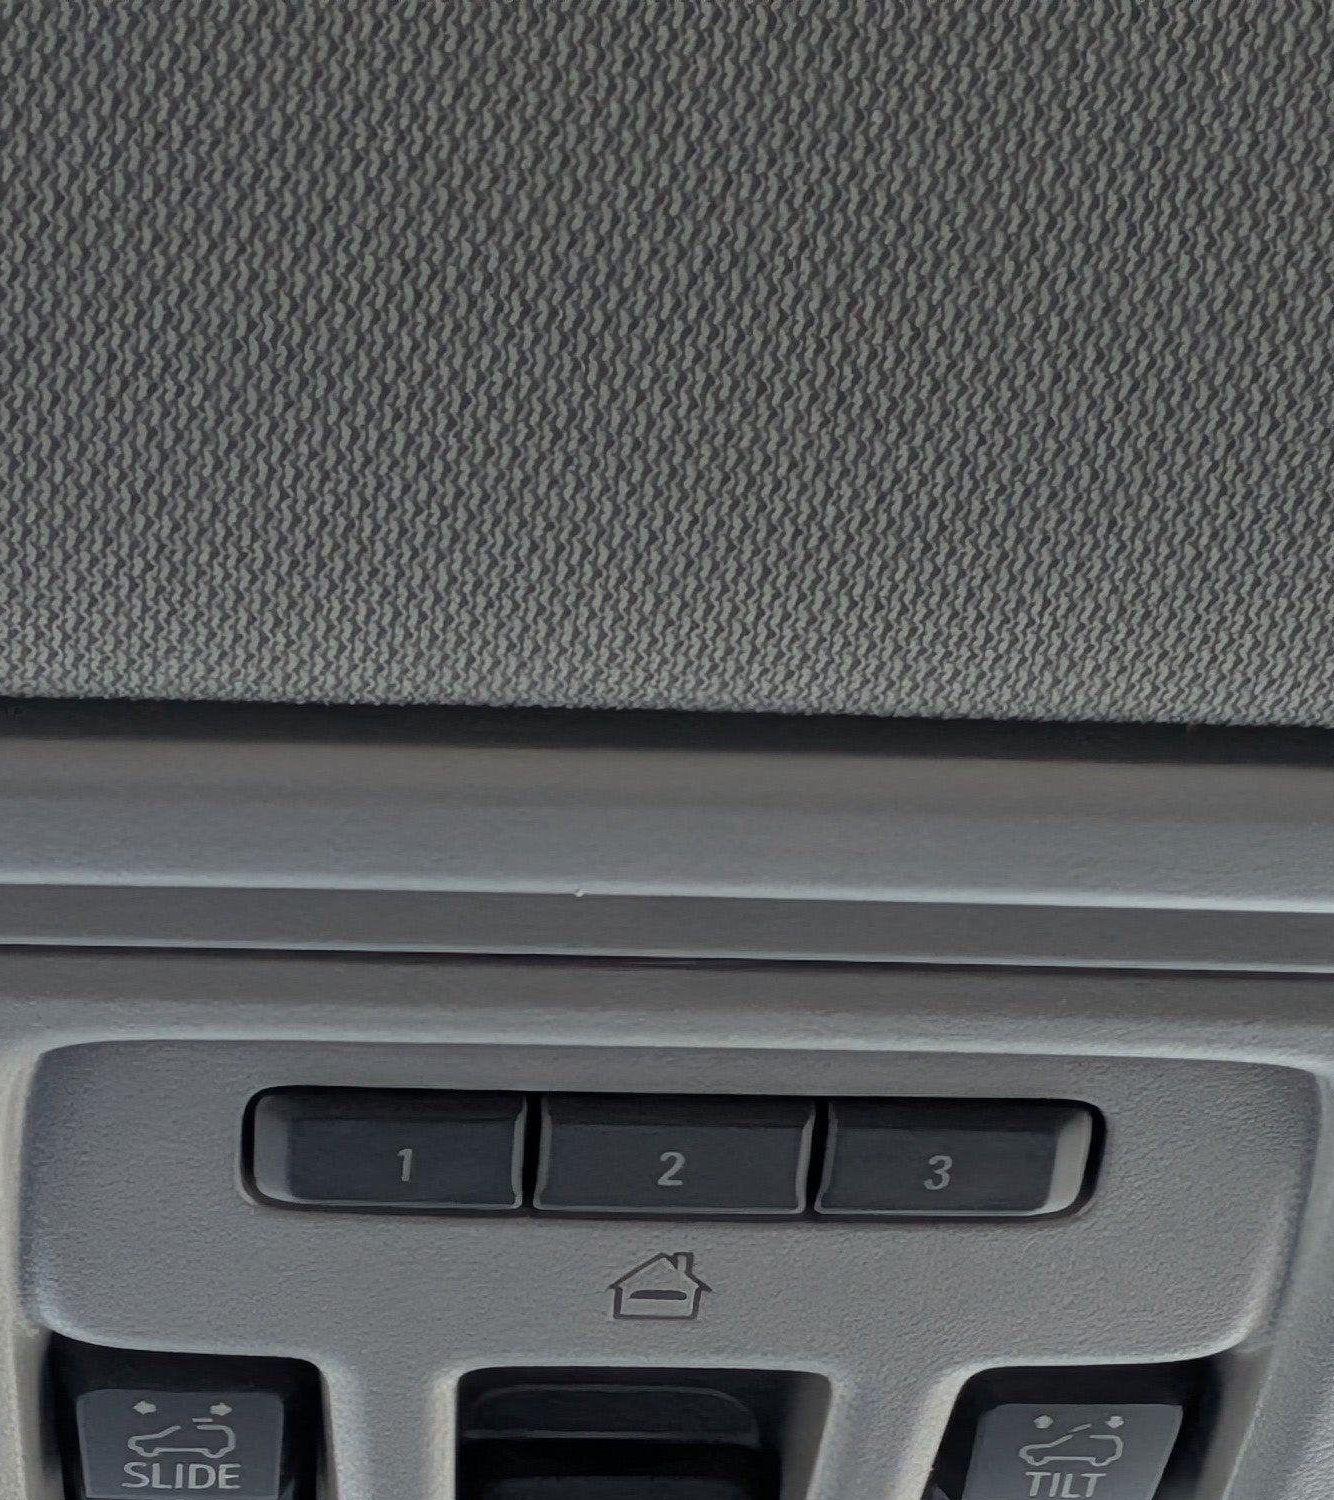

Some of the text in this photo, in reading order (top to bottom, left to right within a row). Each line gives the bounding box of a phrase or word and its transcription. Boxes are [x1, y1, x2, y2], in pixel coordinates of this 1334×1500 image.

[396, 1148, 413, 1182] 1
[657, 1152, 686, 1186] 2
[924, 1155, 952, 1190] 3
[121, 1462, 241, 1489] SLIDE
[1025, 1471, 1105, 1498] TILT
